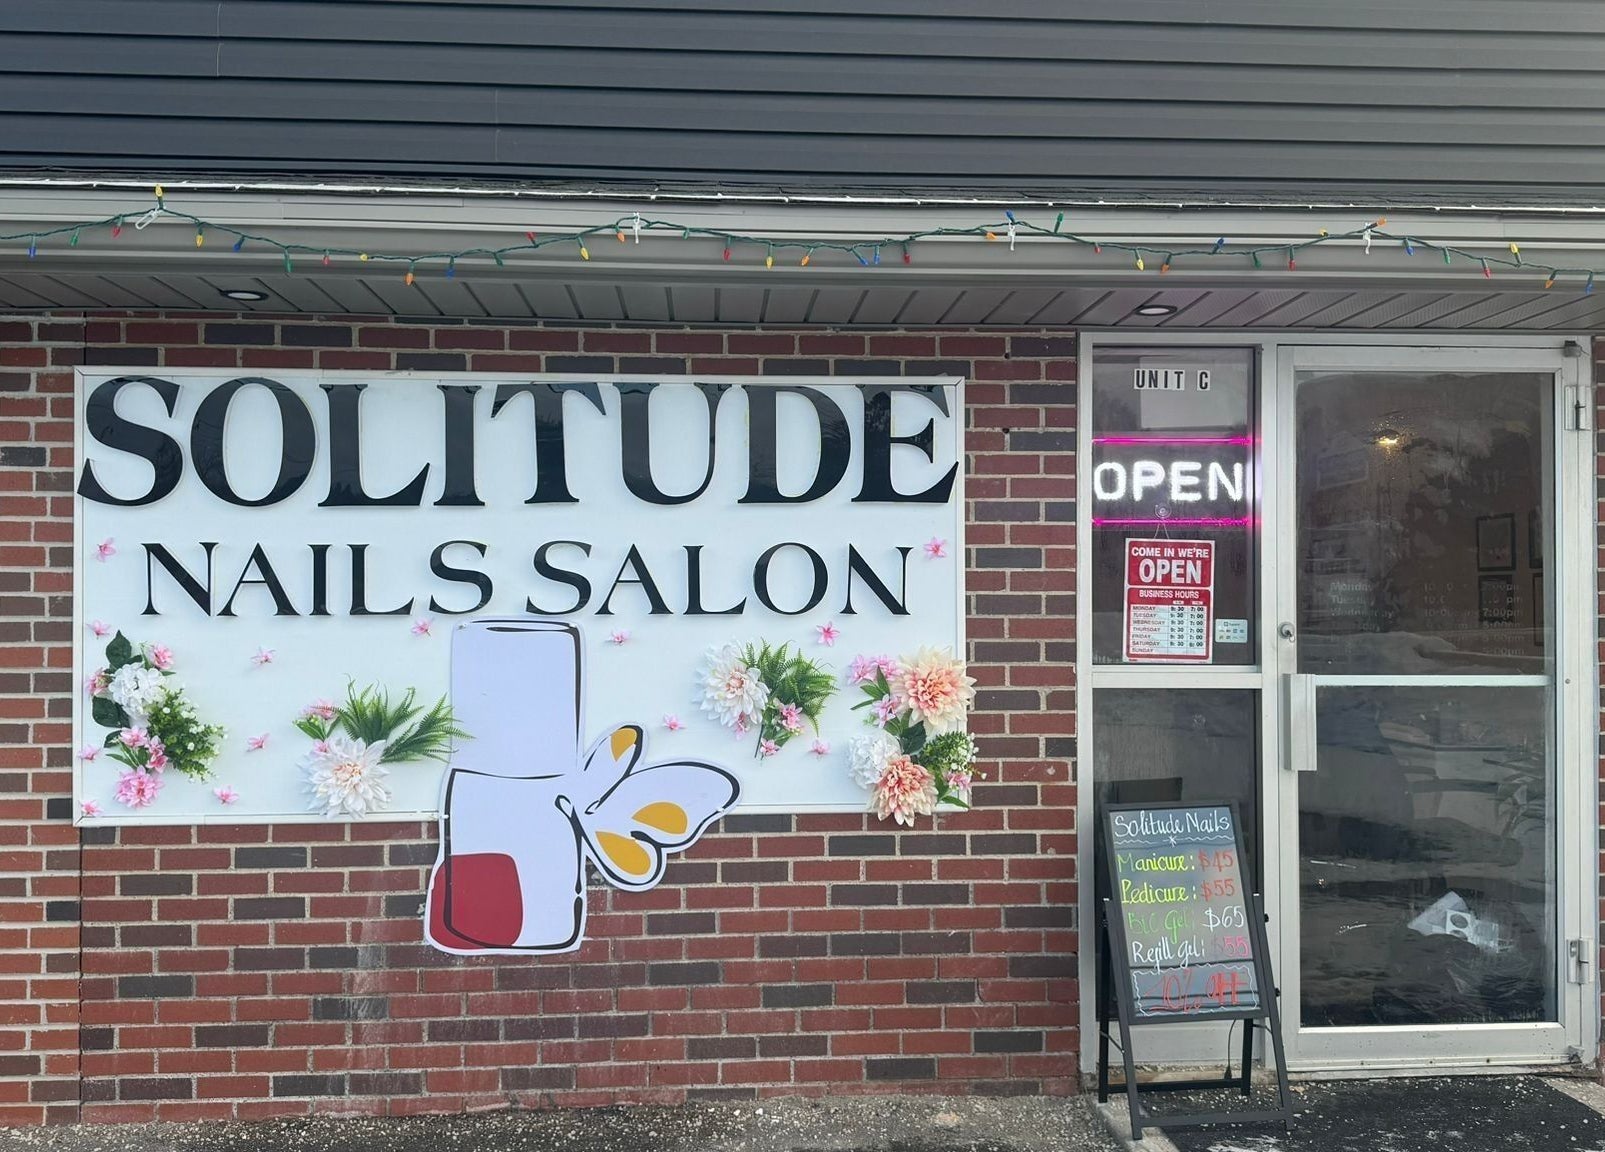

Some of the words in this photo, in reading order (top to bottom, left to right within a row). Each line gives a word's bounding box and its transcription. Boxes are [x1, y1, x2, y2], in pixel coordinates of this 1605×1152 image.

[1136, 370, 1184, 389] UNIT
[1199, 371, 1209, 390] C
[77, 376, 959, 507] SOLITUDE
[1093, 460, 1243, 502] OPEN
[1131, 546, 1161, 557] COME
[1164, 548, 1175, 558] IN
[1178, 548, 1209, 559] WE'RE
[141, 541, 493, 617] NAILS
[526, 541, 912, 617] SALON
[1138, 558, 1202, 584] OPEN
[1139, 589, 1174, 599] BUSINESS
[1175, 590, 1200, 600] HOURS
[1114, 810, 1183, 838] Solitude
[1185, 809, 1230, 833] Nails
[1198, 849, 1234, 873] $45
[1201, 878, 1236, 902] $55
[1202, 905, 1245, 933] $65
